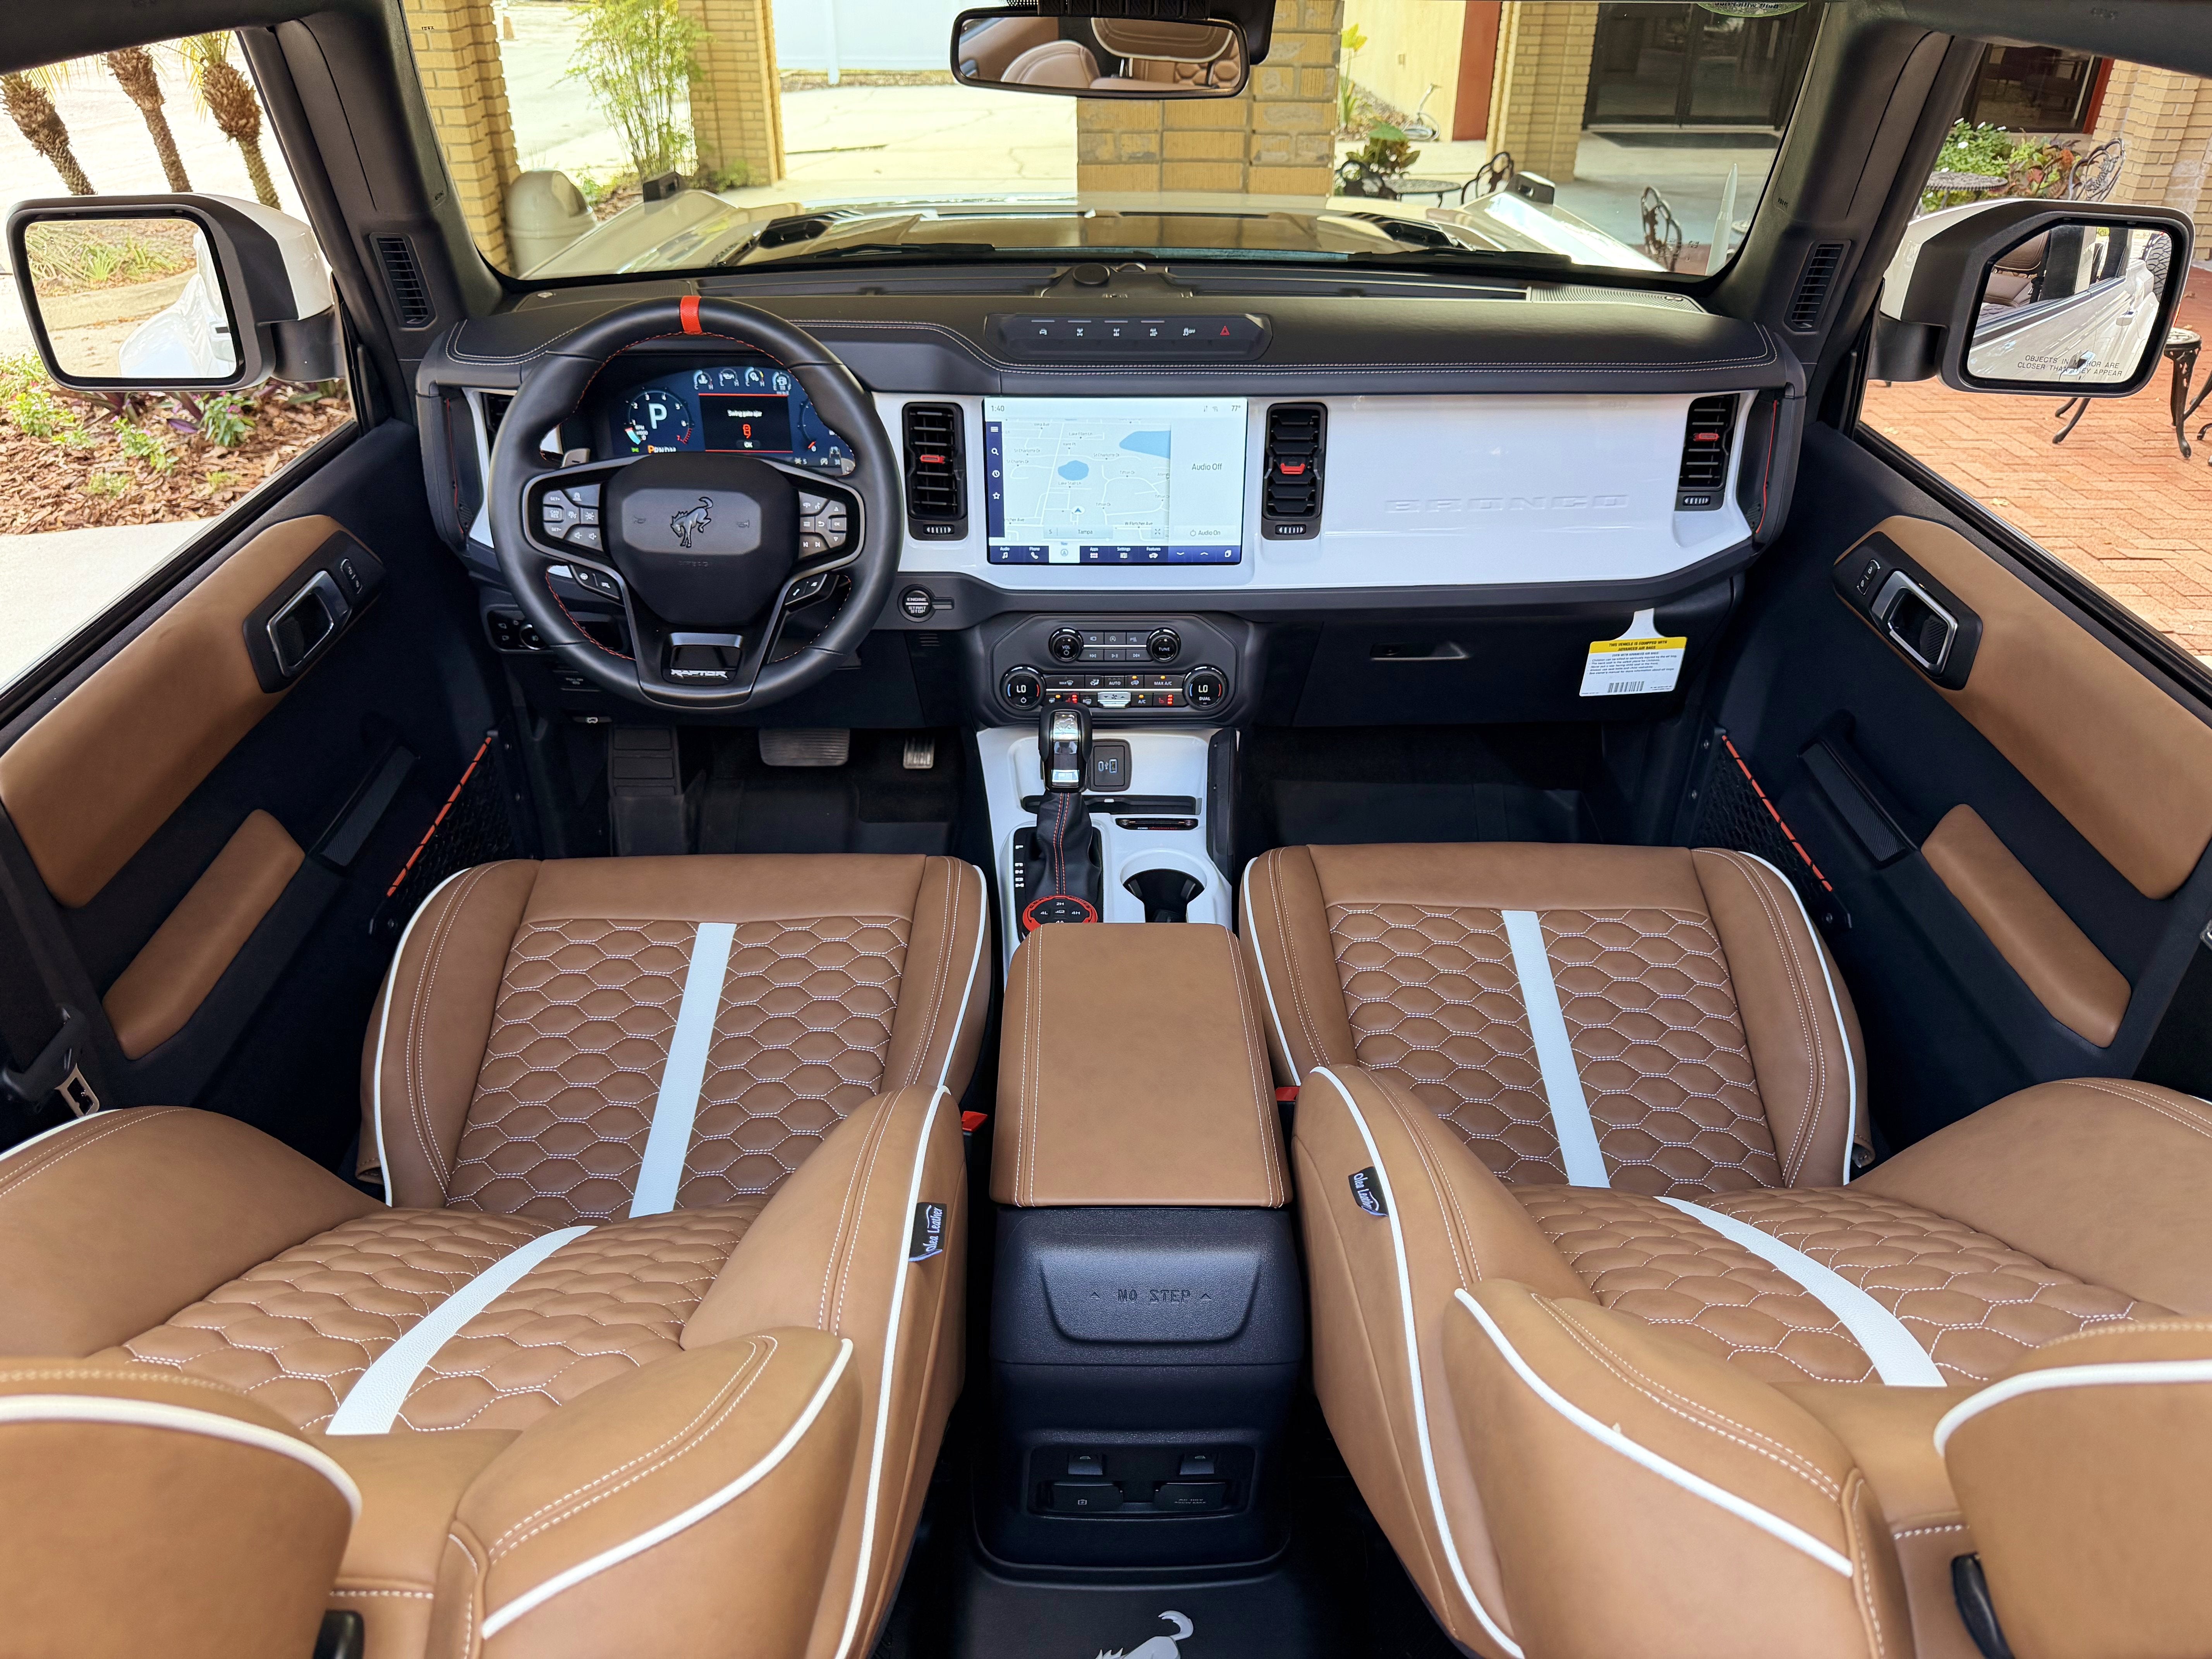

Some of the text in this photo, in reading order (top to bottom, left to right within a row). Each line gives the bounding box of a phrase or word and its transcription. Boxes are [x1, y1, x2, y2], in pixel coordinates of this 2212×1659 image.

[2025, 355, 2058, 364] OBJECTS
[2093, 369, 2123, 377] APPEAR
[648, 403, 667, 429] P
[1385, 495, 1629, 513] BRONCO
[671, 669, 728, 679] RAPTOR
[1016, 685, 1026, 693] LO
[1198, 685, 1208, 693] LO
[927, 1207, 943, 1233] Leather
[1118, 1289, 1190, 1303] NO STEP
